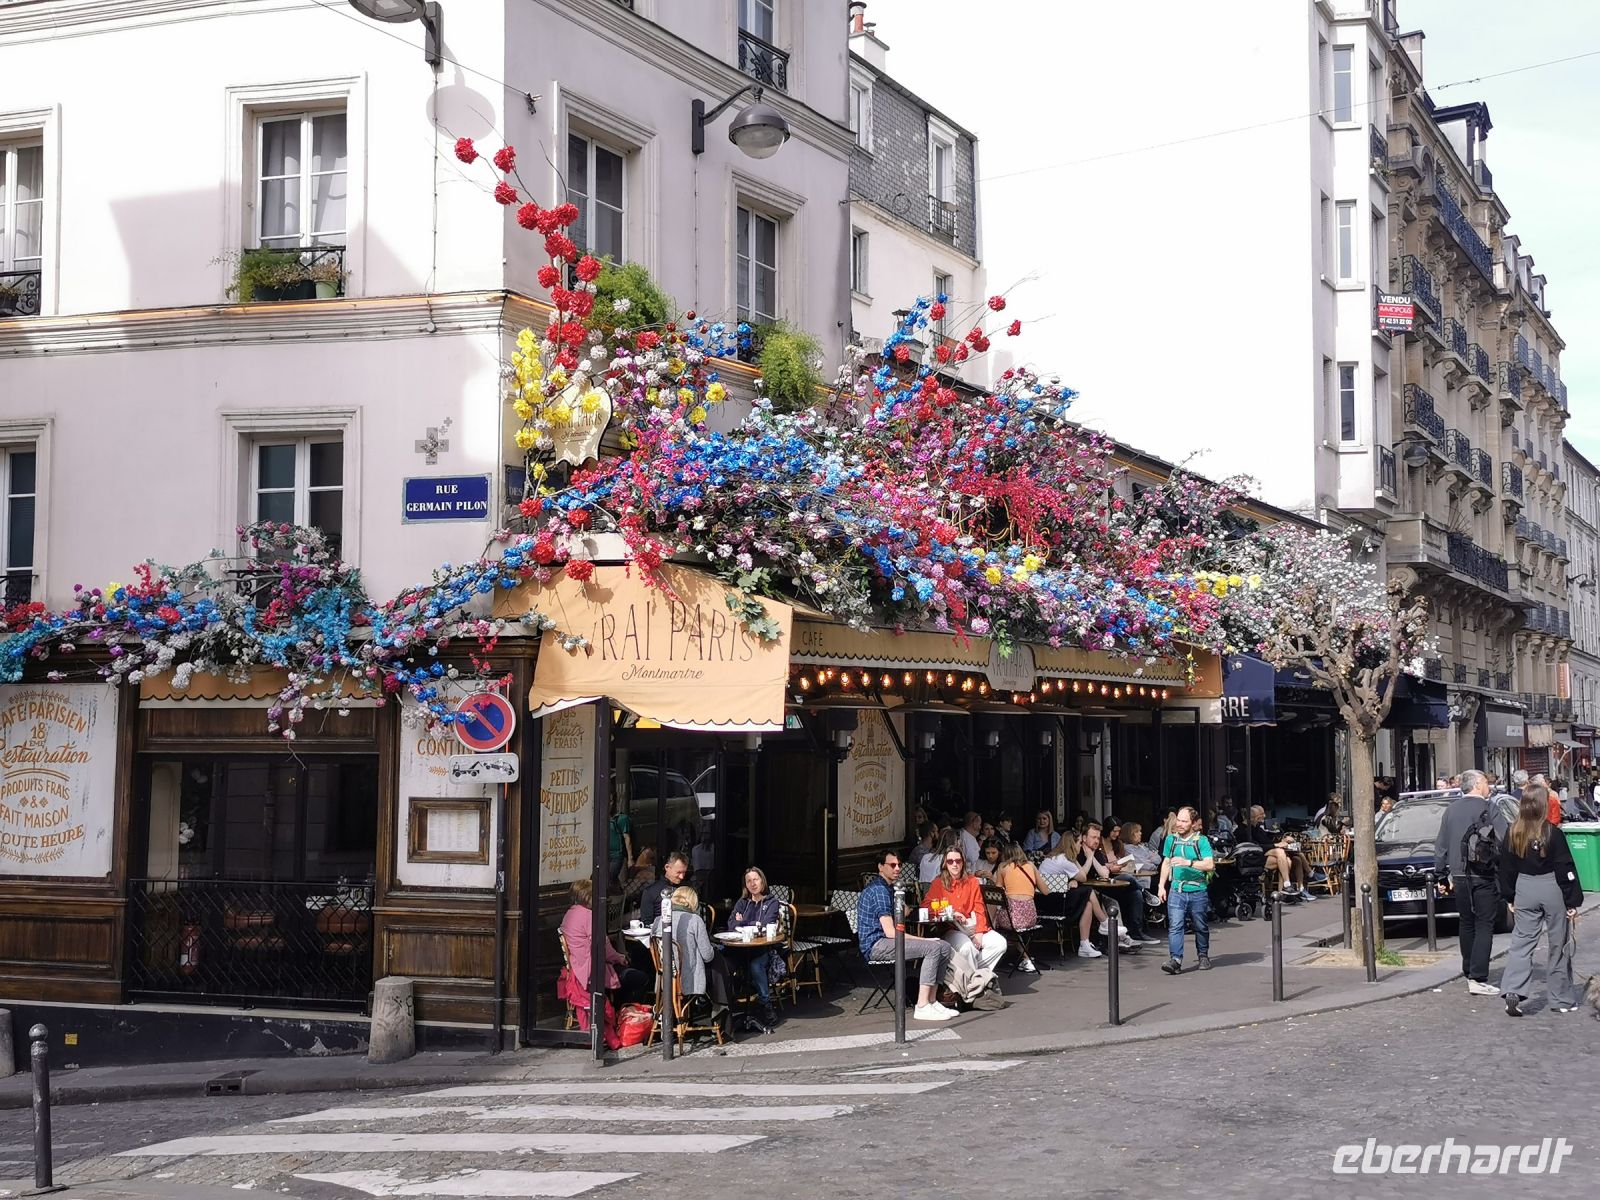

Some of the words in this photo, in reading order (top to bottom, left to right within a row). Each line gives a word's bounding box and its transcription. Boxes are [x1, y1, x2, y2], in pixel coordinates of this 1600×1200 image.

[1380, 295, 1411, 304] VENDU
[436, 484, 458, 494] RUE
[509, 487, 523, 496] DES
[406, 501, 452, 512] GERMAIN
[456, 500, 487, 511] PILON
[669, 600, 753, 662] PARIS
[621, 663, 705, 681] Montmartre
[29, 701, 87, 734] PARISIEN
[31, 721, 46, 740] 18
[554, 737, 578, 749] FRAIS
[550, 768, 580, 787] PETITS
[1, 778, 43, 800] PRODUITS
[46, 780, 70, 801] FRAIS
[30, 795, 37, 808] &
[0, 803, 22, 827] FAIT
[24, 805, 69, 829] MAISON
[40, 824, 85, 848] HEURE
[549, 836, 580, 849] DESSERTS
